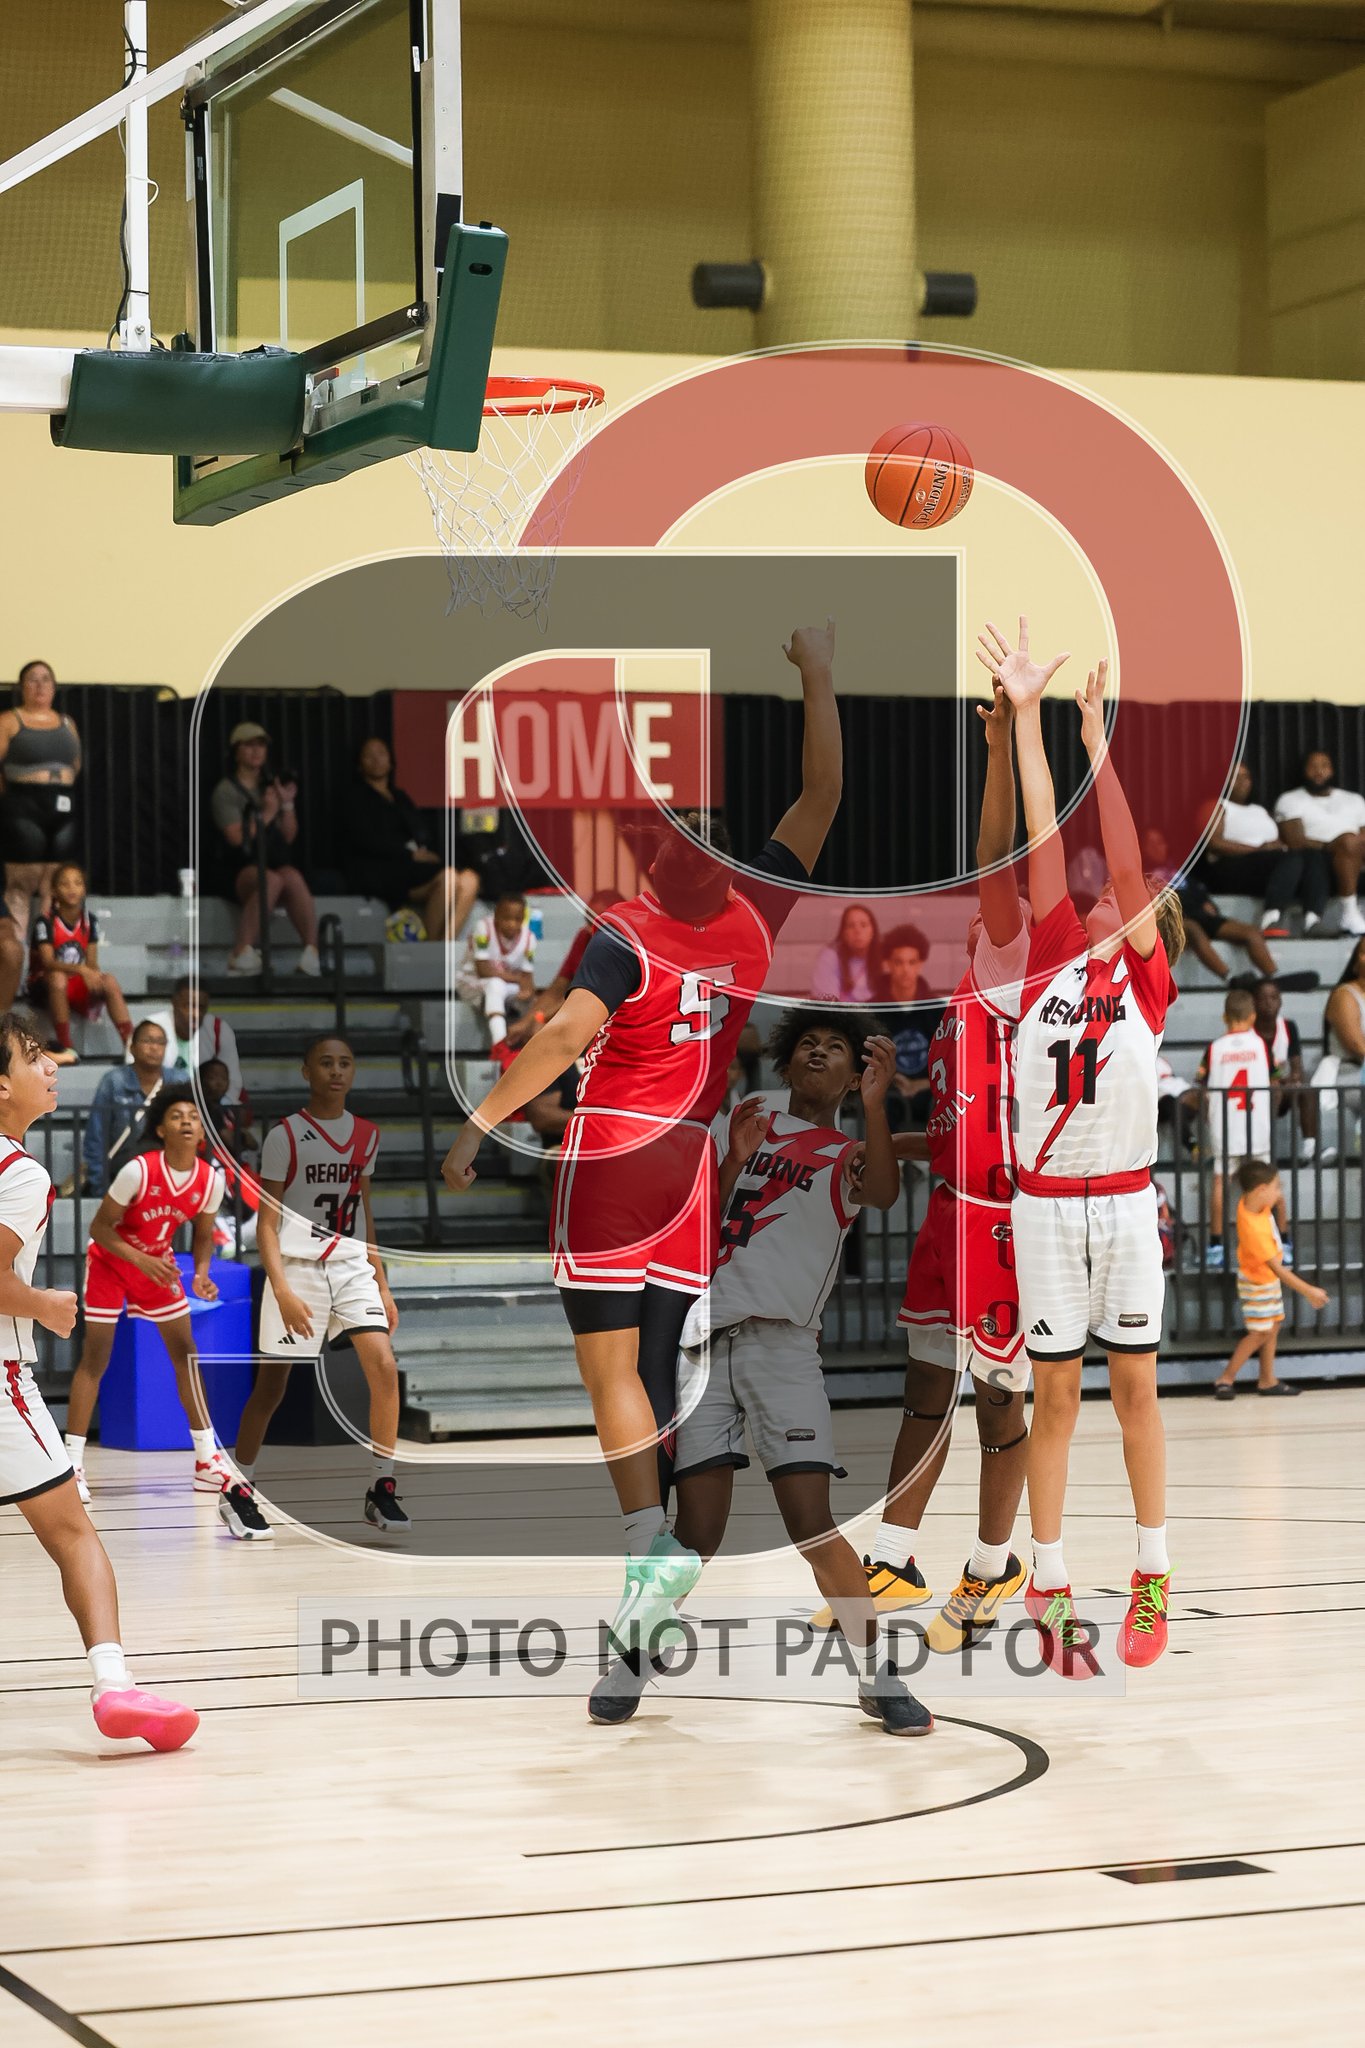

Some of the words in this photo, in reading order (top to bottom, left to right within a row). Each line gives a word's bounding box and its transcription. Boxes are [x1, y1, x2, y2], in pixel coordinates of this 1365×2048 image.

[912, 461, 951, 525] SPALDING
[446, 701, 674, 800] HOME
[668, 960, 738, 1046] 5
[1047, 1038, 1099, 1106] 11
[1227, 1068, 1256, 1111] 4
[155, 1220, 171, 1242] 1
[311, 1193, 362, 1238] 30
[719, 1187, 765, 1249] 5
